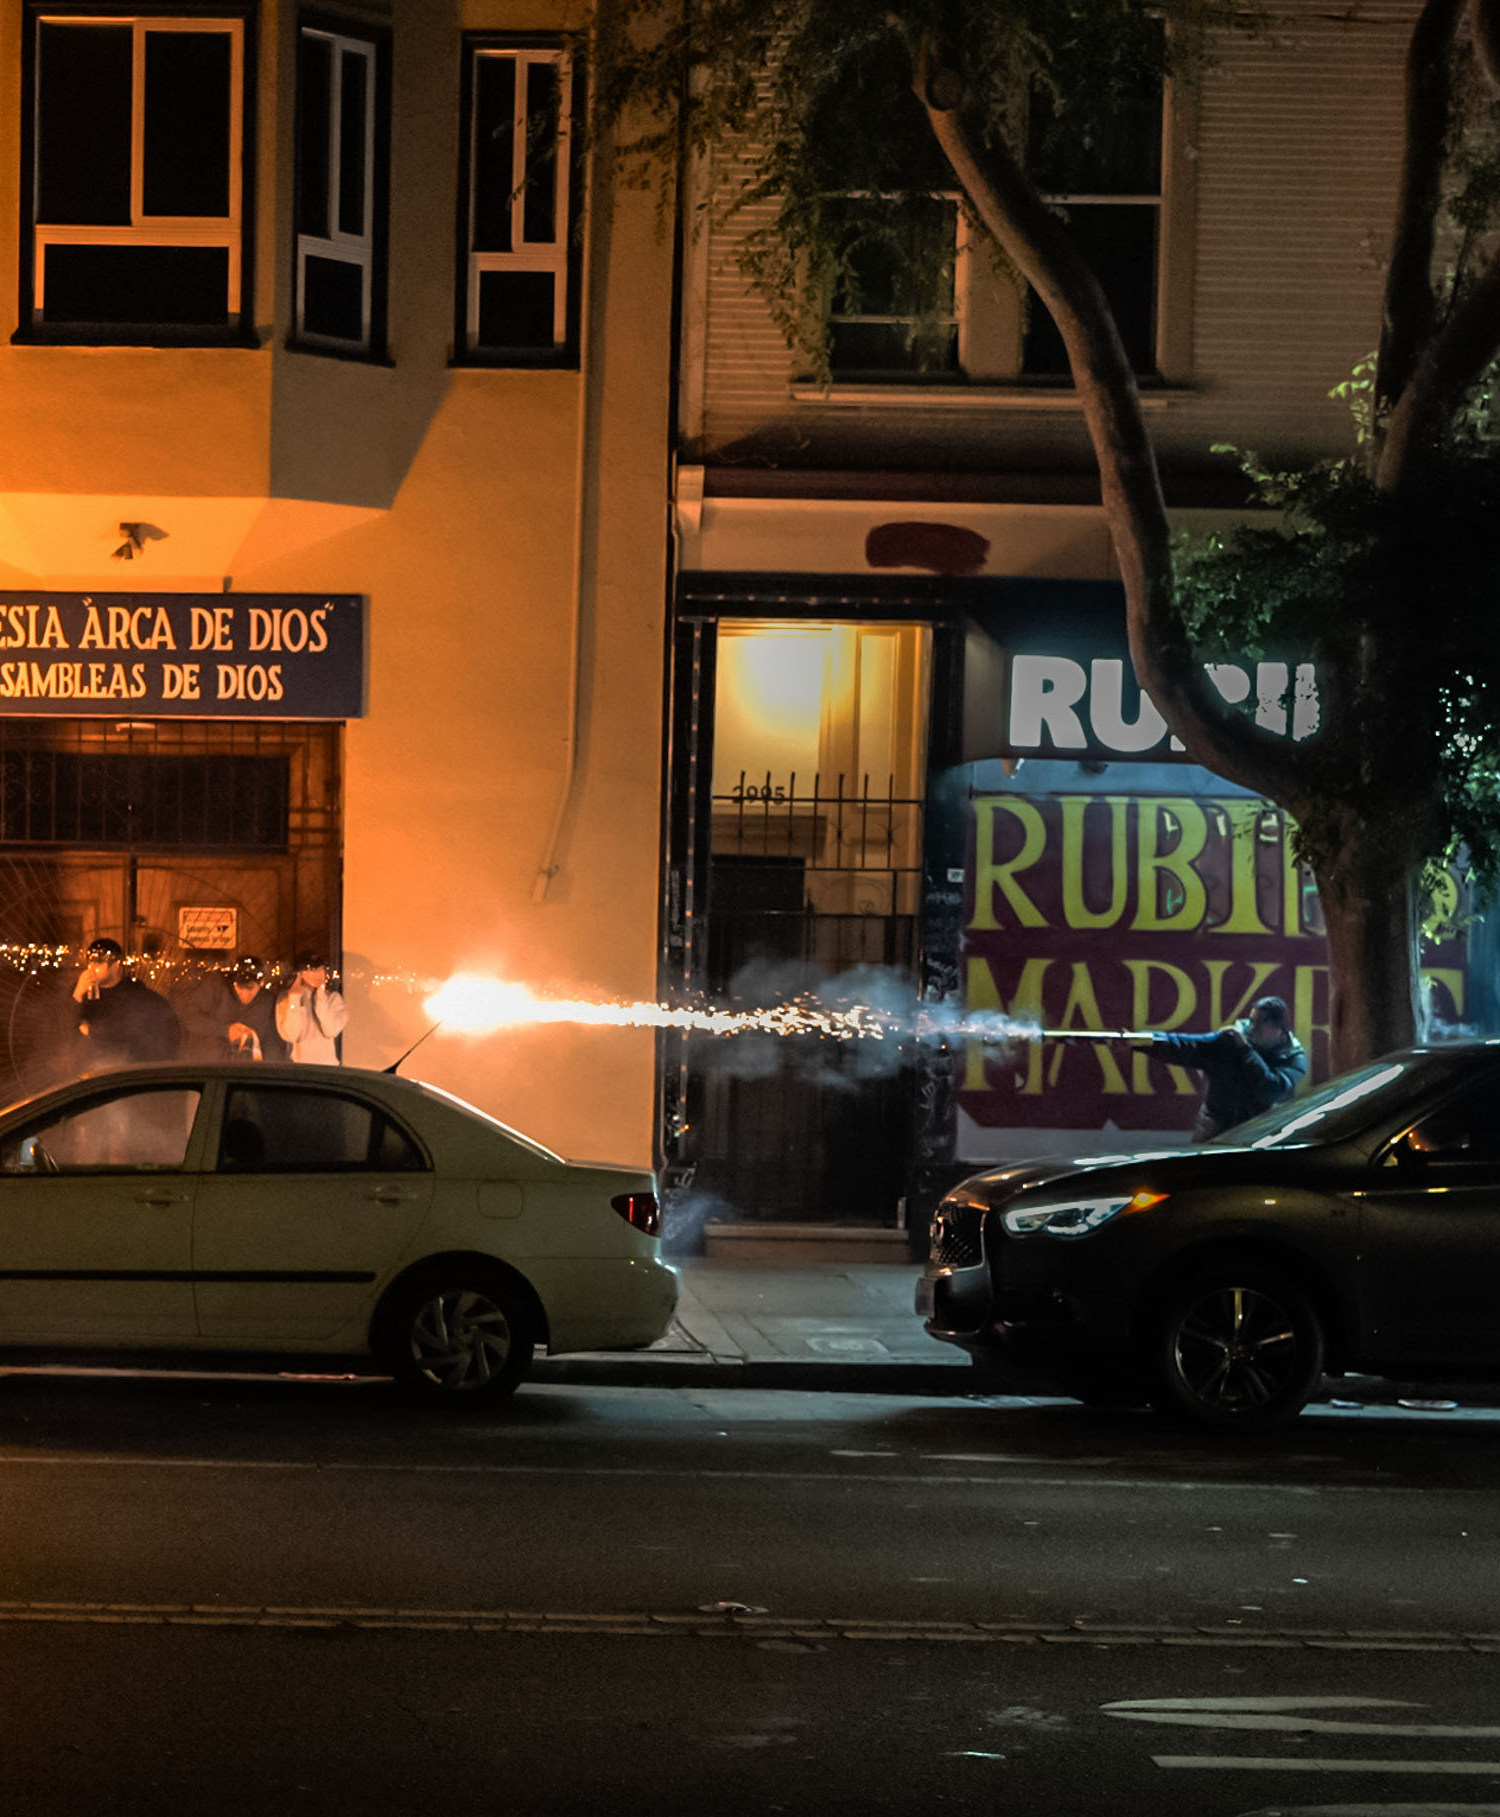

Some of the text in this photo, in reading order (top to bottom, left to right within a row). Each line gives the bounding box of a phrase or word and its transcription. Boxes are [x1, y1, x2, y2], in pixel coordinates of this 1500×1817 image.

[190, 607, 234, 652] DE
[162, 664, 200, 700] DE
[217, 665, 283, 701] DIOS
